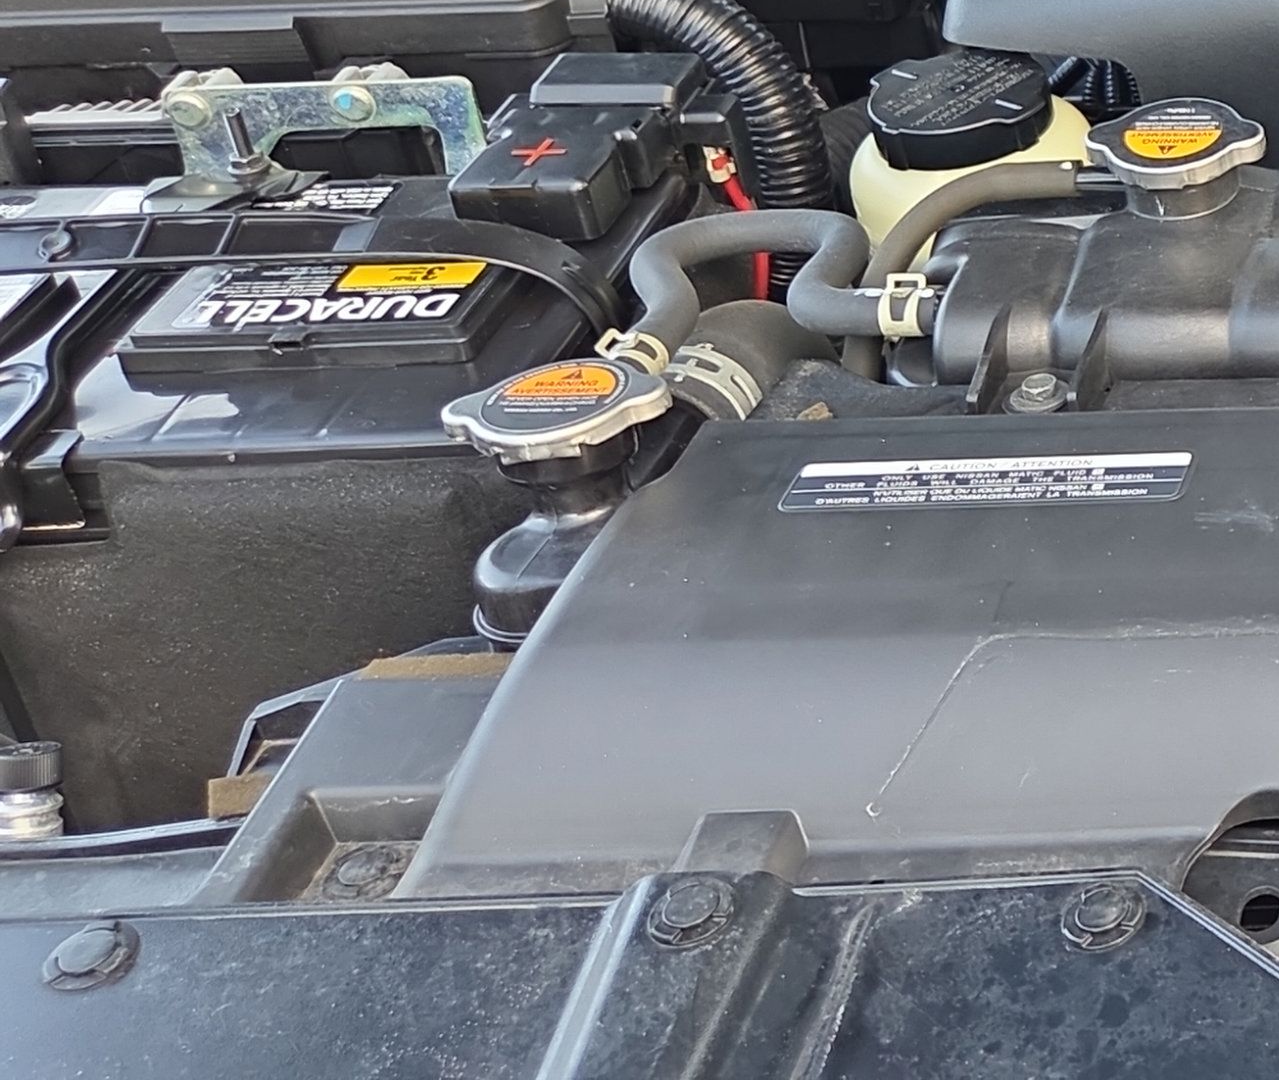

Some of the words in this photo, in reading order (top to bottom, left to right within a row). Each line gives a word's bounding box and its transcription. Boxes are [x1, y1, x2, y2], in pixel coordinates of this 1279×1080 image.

[421, 266, 446, 281] 3
[197, 294, 460, 323] DURACELL
[929, 461, 997, 471] CAUTION
[1009, 458, 1094, 469] ATTENTION
[955, 471, 999, 479] NISSAN
[1067, 473, 1154, 481] TRANSMISSION
[1067, 489, 1148, 497] TRANSMISSION
